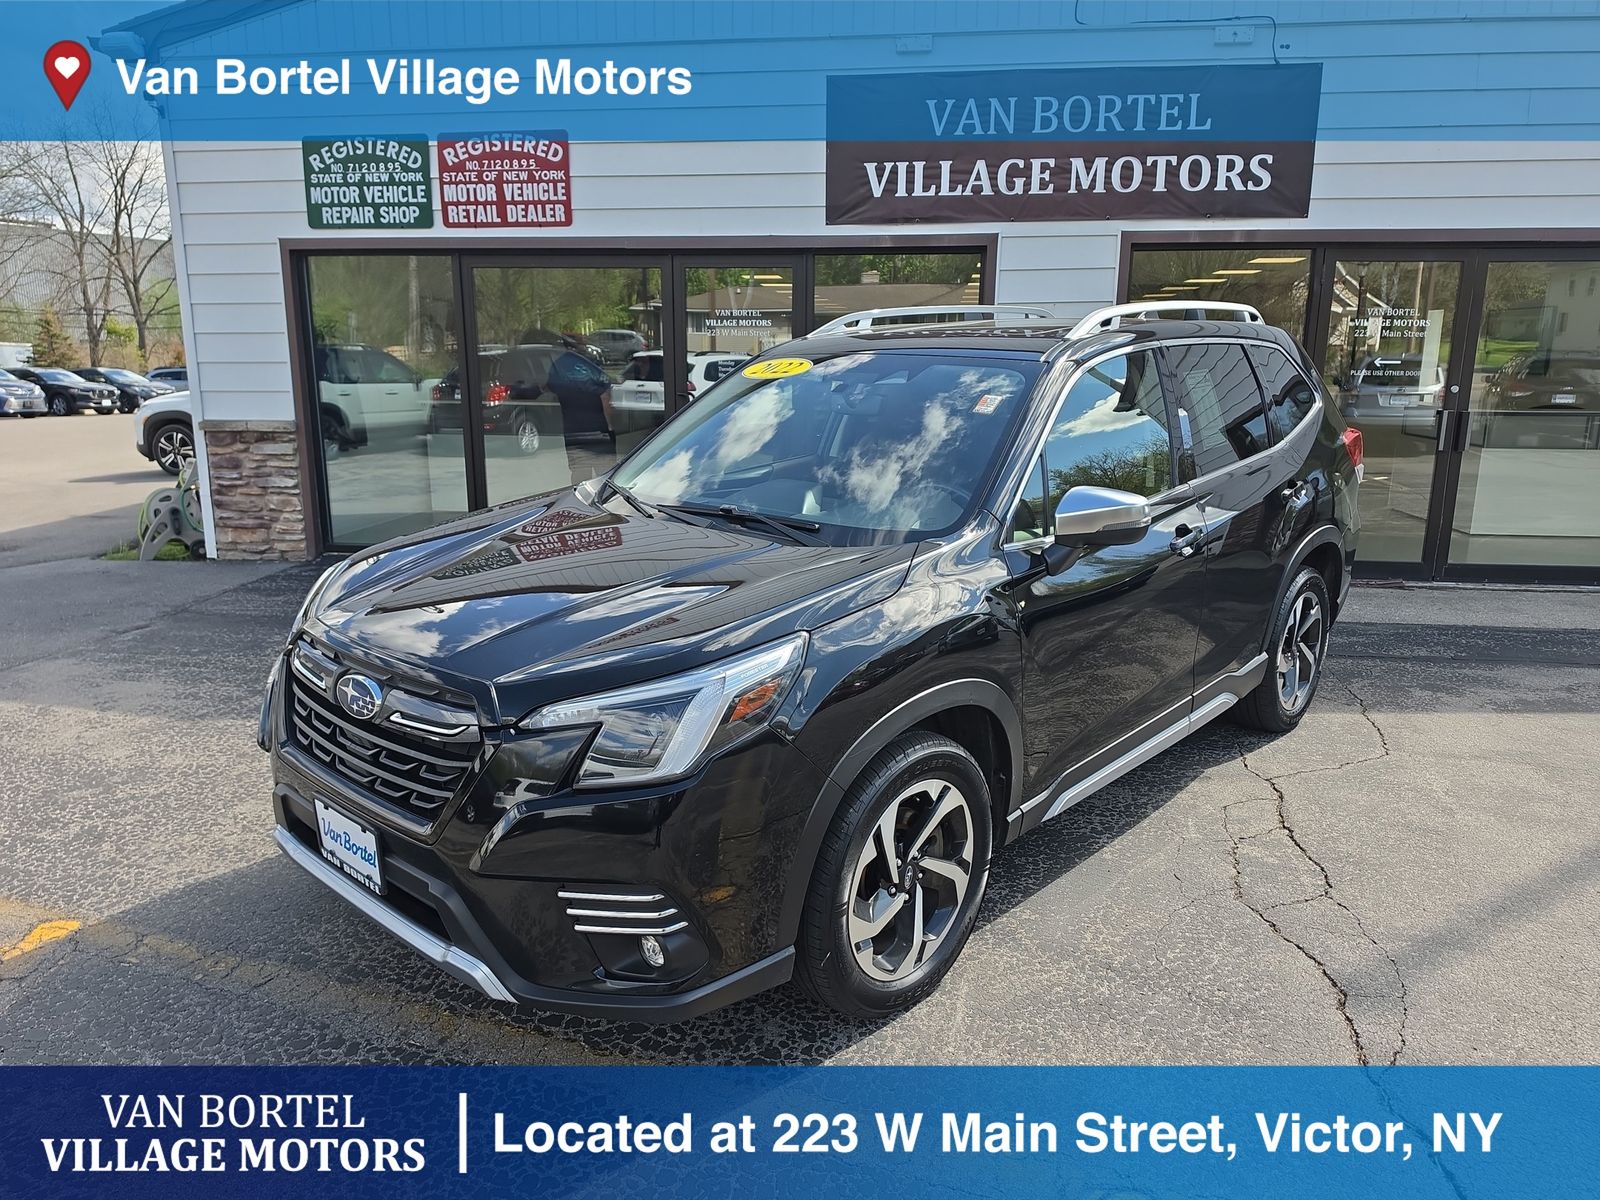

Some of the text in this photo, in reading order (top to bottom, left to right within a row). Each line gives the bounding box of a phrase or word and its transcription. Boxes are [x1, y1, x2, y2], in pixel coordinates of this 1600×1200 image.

[926, 93, 1212, 137] VAN BORTEL
[308, 137, 422, 172] REGISTERED
[442, 133, 564, 166] REGISTERED
[347, 162, 402, 173] 7120895
[482, 159, 537, 170] 7120895
[310, 172, 424, 183] STATE OF NEW YORK
[442, 170, 566, 182] STATE OF NEW YORK
[863, 154, 1274, 198] VILLAGE MOTORS
[309, 185, 428, 204] MOTOR VEHICLE
[443, 182, 567, 203] MOTOR VEHICLE
[321, 205, 420, 225] REPAIR SHOP
[447, 203, 566, 223] RETAIL DEALER
[732, 309, 762, 317] BORTEL
[1367, 308, 1421, 316] VAN BORTEL
[705, 319, 772, 327] VILLAGE MOTORS
[1392, 319, 1431, 327] MOTORS
[731, 329, 749, 337] Main
[749, 329, 771, 337] Street
[1382, 329, 1402, 337] Main
